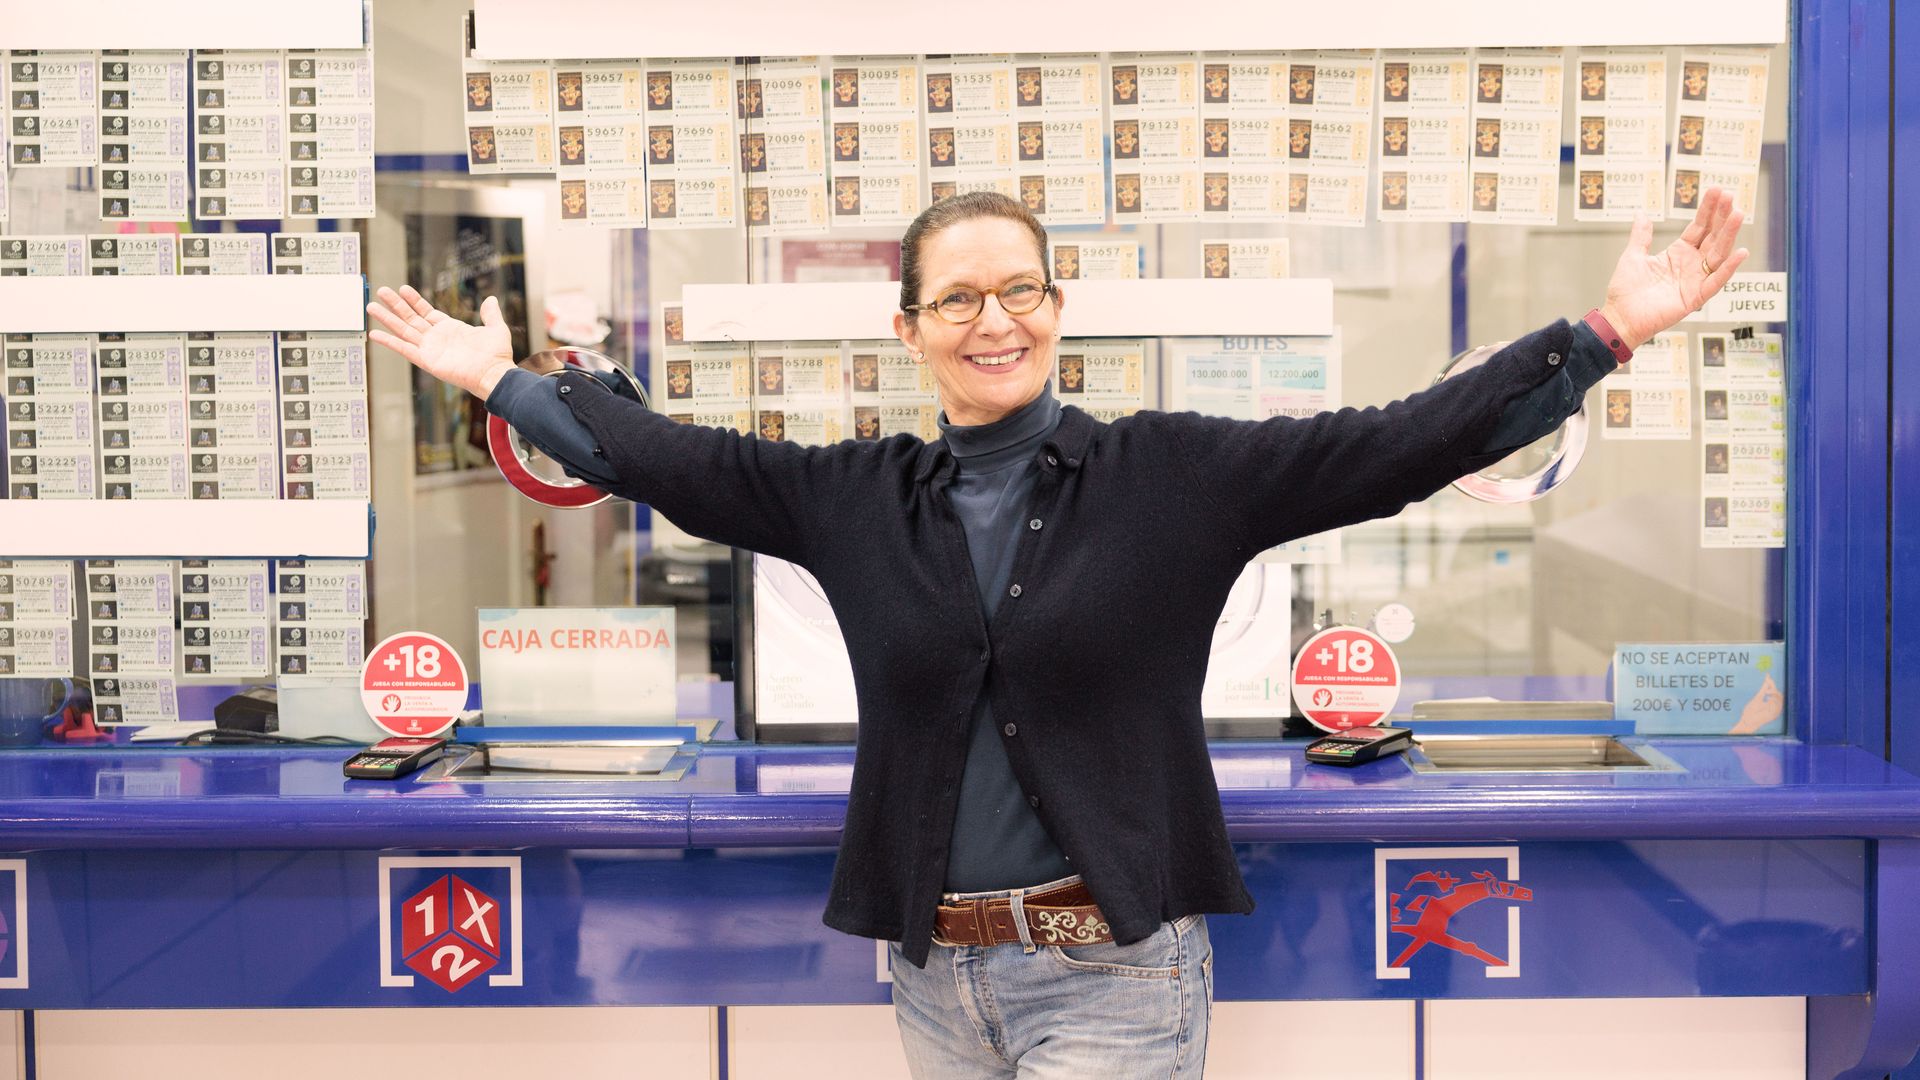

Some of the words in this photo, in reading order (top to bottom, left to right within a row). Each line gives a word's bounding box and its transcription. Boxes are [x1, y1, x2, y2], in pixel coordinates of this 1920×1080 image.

[40, 65, 78, 74] 76241
[131, 65, 168, 73] 56161
[226, 64, 263, 72] 17451
[318, 62, 355, 70] 71230
[1411, 66, 1449, 74] 01432
[1608, 65, 1646, 73] 80201
[860, 70, 898, 79] 30095
[1043, 68, 1081, 77] 86274
[1139, 67, 1177, 75] 79123
[1231, 67, 1270, 75] 55402
[1317, 69, 1356, 79] 44562
[1505, 68, 1543, 76] 52121
[1711, 66, 1749, 76] 71230
[493, 74, 531, 83] 62407
[585, 74, 623, 82] 59657
[674, 73, 712, 82] 75696
[954, 74, 992, 84] 51535
[764, 80, 802, 89] 70096
[42, 119, 79, 128] 76241
[131, 119, 168, 128] 56161
[228, 118, 264, 126] 17451
[319, 116, 357, 124] 71230
[862, 124, 899, 133] 30095
[1045, 122, 1083, 131] 86274
[1141, 121, 1178, 130] 79123
[1232, 121, 1270, 129] 55402
[1313, 123, 1352, 133] 44562
[1503, 122, 1540, 130] 52121
[1707, 120, 1744, 131] 71230
[587, 128, 624, 136] 59657
[676, 127, 713, 136] 75696
[956, 128, 994, 137] 51535
[768, 135, 805, 143] 70096
[131, 173, 168, 182] 56161
[229, 172, 265, 180] 17451
[320, 170, 357, 179] 71230
[1409, 174, 1448, 182] 01432
[1606, 174, 1644, 182] 80201
[863, 178, 900, 186] 30095
[1046, 176, 1085, 185] 86274
[1143, 175, 1180, 184] 79123
[1231, 175, 1269, 184] 55402
[1310, 177, 1348, 187] 44562
[1500, 177, 1538, 185] 52121
[1702, 175, 1740, 185] 71230
[589, 181, 626, 190] 59657
[678, 181, 715, 190] 75696
[959, 183, 996, 192] 51535
[771, 188, 808, 197] 70096
[29, 243, 66, 252] 27204
[120, 241, 158, 250] 71614
[213, 240, 250, 249] 15414
[303, 240, 342, 249] 06357
[1082, 247, 1120, 257] 59657
[1232, 246, 1269, 254] 23159
[1723, 282, 1782, 292] ESPECIAL
[1730, 300, 1775, 312] JUEVES
[36, 351, 73, 360] 52225
[128, 351, 165, 359] 28305
[694, 361, 732, 370] 95228
[785, 359, 823, 367] 65788
[1086, 357, 1124, 366] 50789
[1635, 392, 1672, 400] 17451
[38, 405, 74, 413] 52225
[130, 404, 167, 412] 28305
[312, 403, 349, 412] 79123
[1088, 410, 1124, 418] 0789
[696, 415, 734, 424] 95228
[314, 457, 352, 465] 79123
[483, 629, 542, 653] CAJA
[551, 629, 670, 648] CERRADA
[1316, 640, 1374, 672] +18
[1622, 653, 1644, 664] NO
[1650, 653, 1668, 664] SE
[1675, 653, 1749, 664] ACEPTAN
[383, 645, 441, 678] +18
[1636, 676, 1708, 688] BILLETES
[1714, 676, 1734, 688] DE
[1633, 699, 1672, 711] 200€
[1677, 699, 1687, 711] Y
[1693, 699, 1732, 711] 500€
